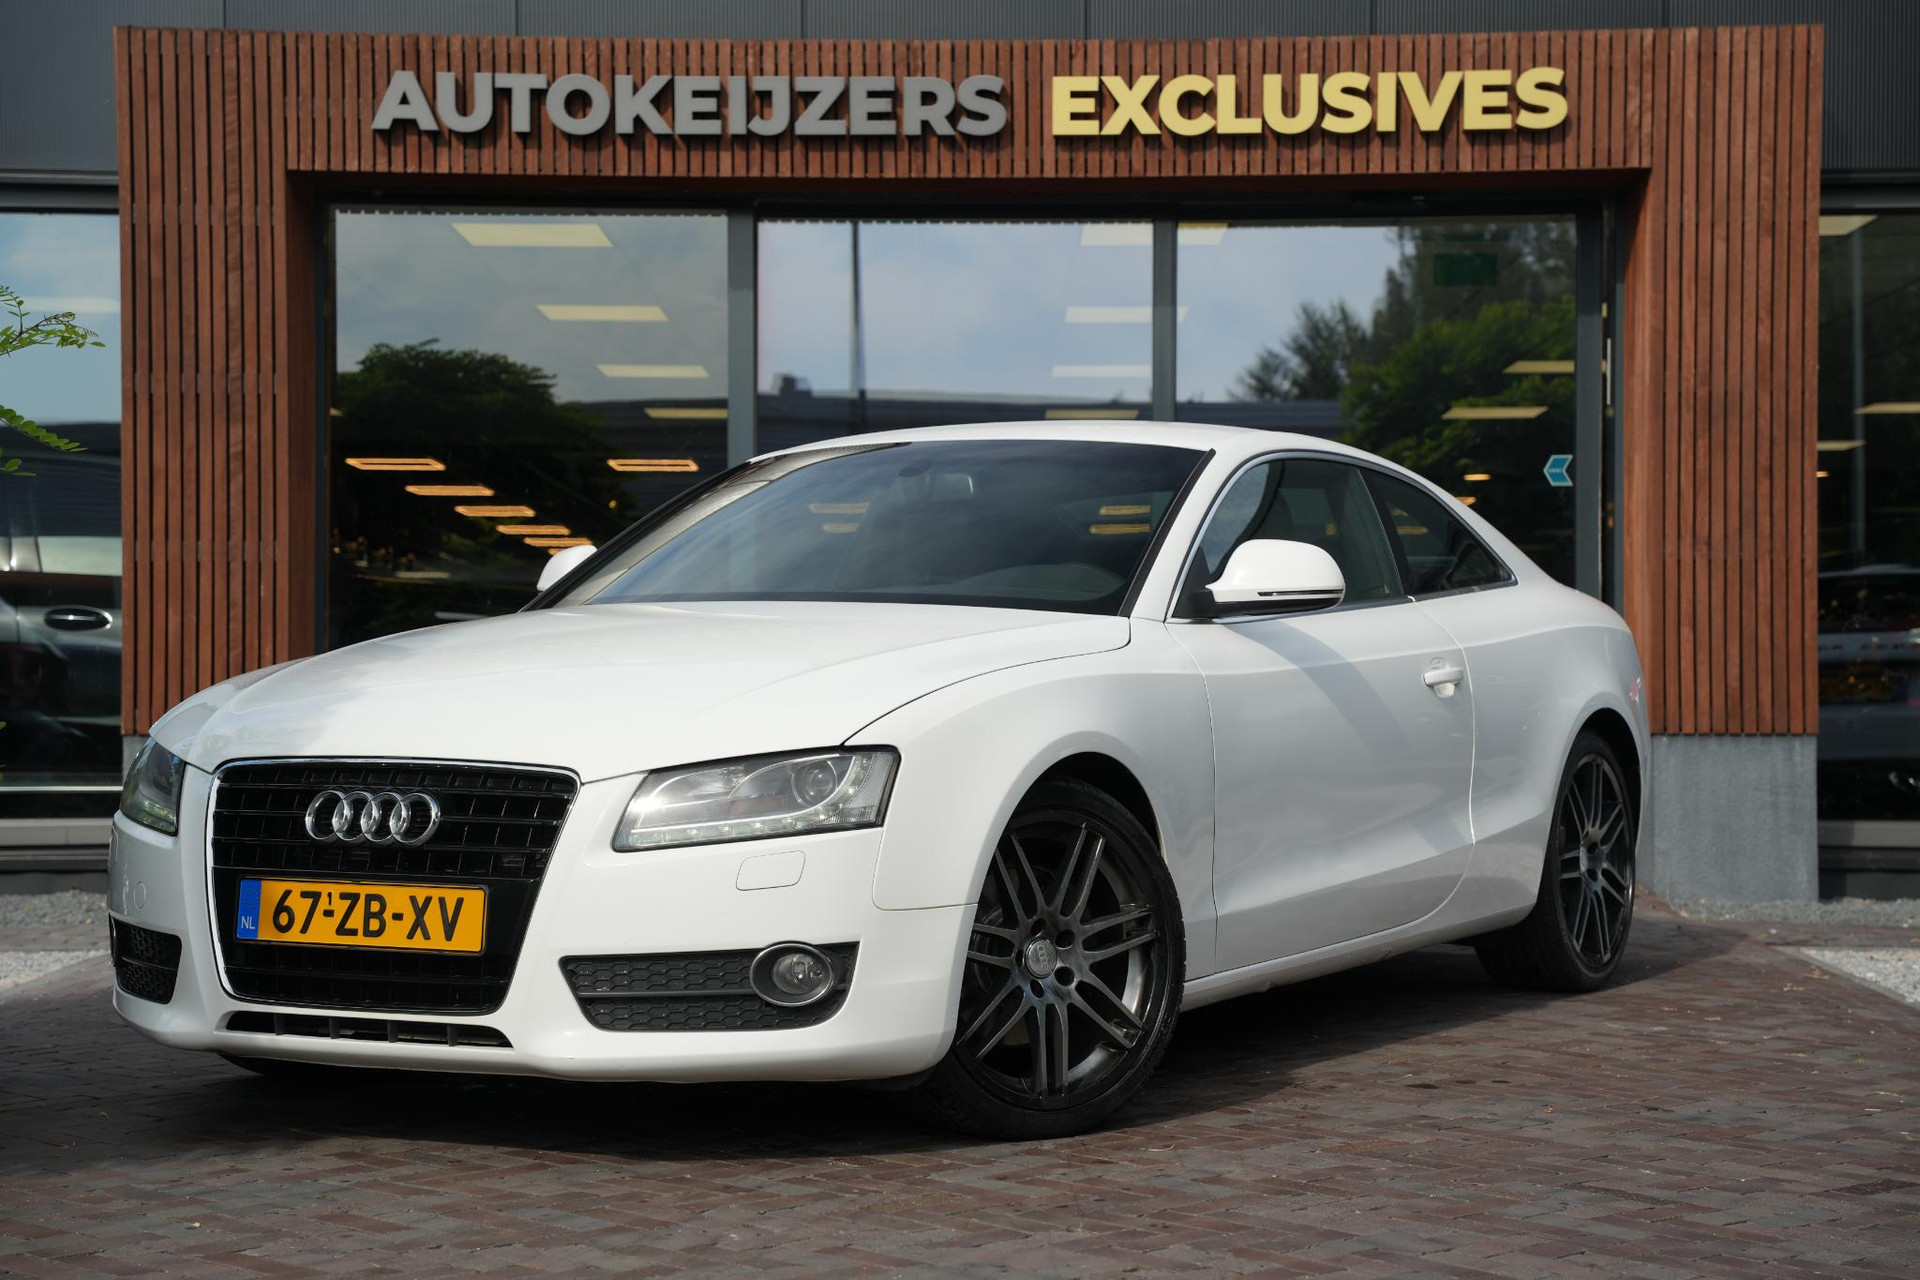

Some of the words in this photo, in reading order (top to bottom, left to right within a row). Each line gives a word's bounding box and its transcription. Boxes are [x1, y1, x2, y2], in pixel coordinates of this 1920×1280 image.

[371, 70, 1007, 136] AUTOKEIJZERS
[1052, 66, 1568, 137] EXCLUSIVES
[241, 915, 256, 930] NL
[272, 888, 464, 942] 67-ZB-XV
